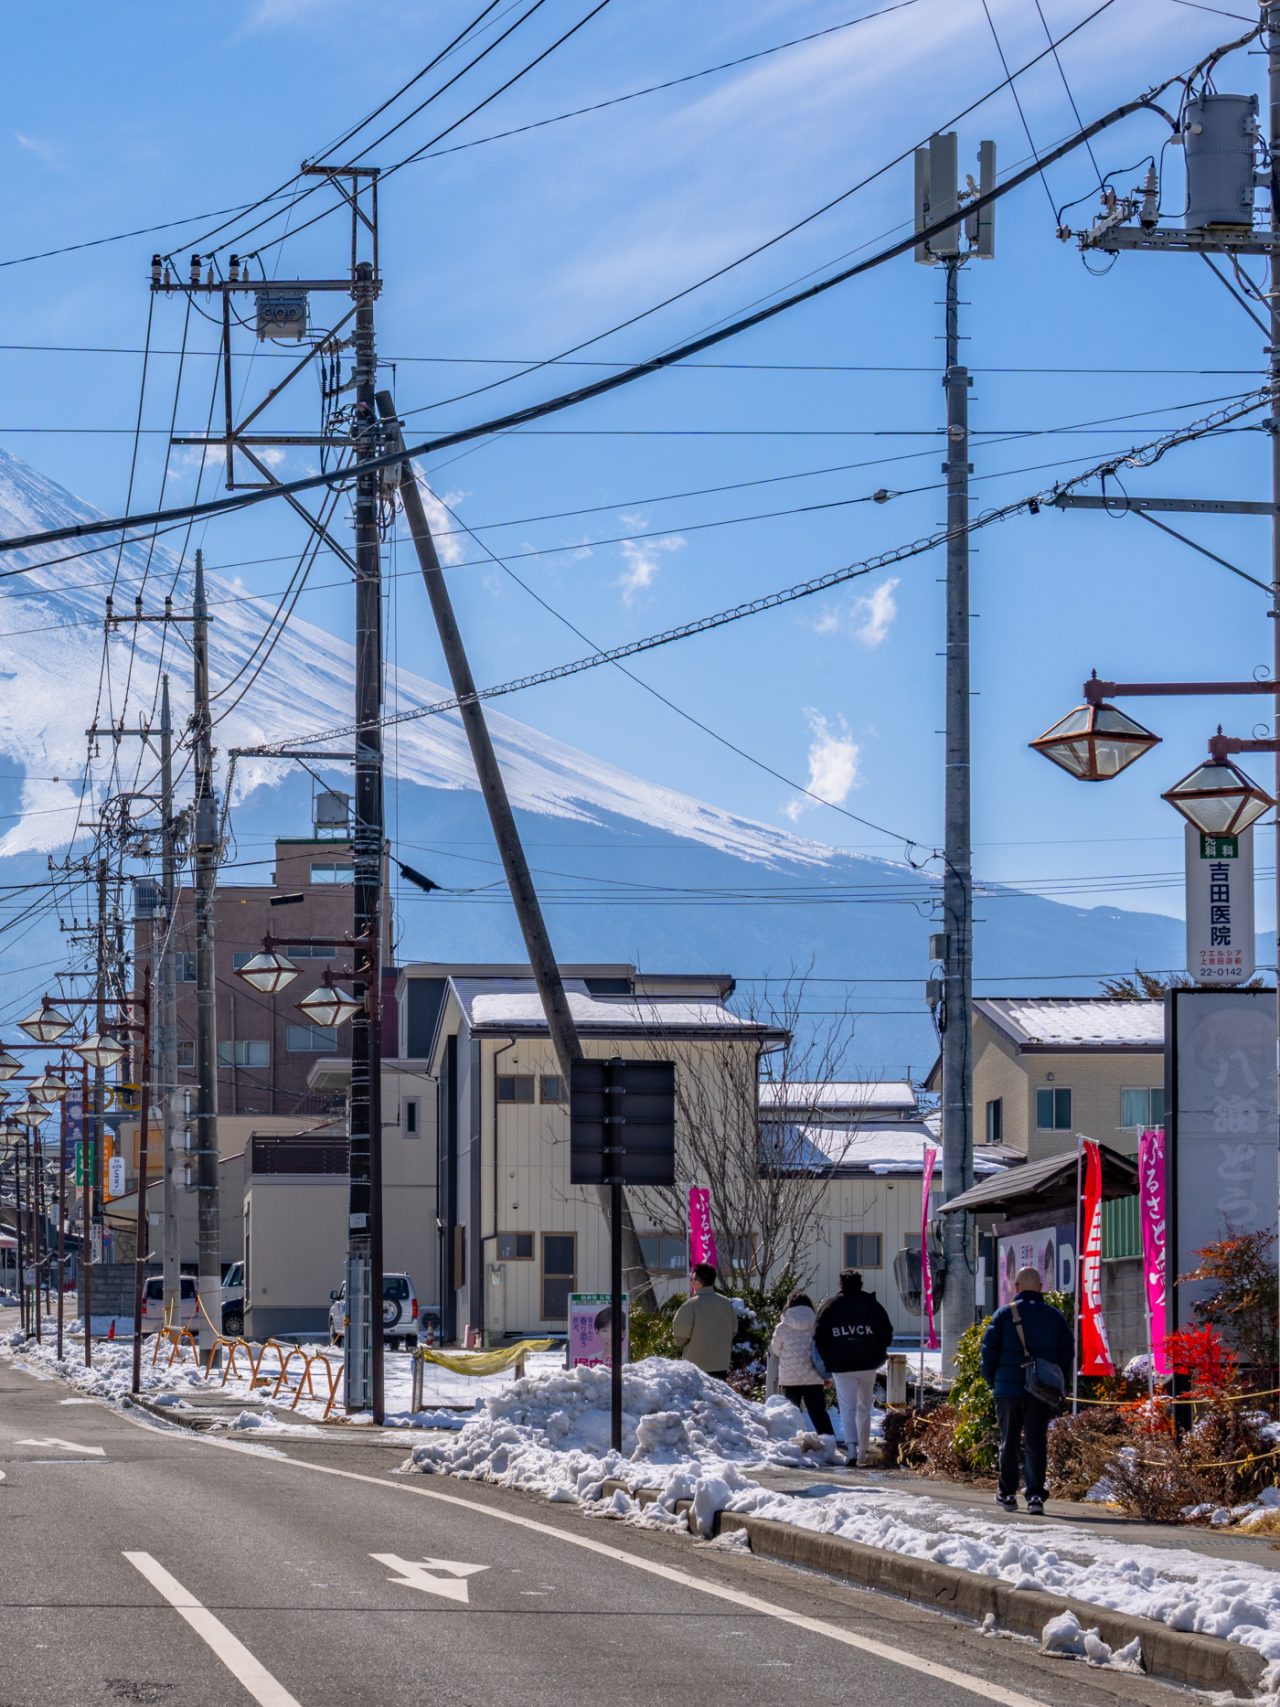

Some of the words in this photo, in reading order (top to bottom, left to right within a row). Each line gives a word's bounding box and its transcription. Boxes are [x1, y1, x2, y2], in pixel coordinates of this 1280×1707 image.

[1209, 861, 1231, 946] 吉田医院
[1200, 967, 1242, 976] 22-0142
[832, 1325, 873, 1337] BLVCK
